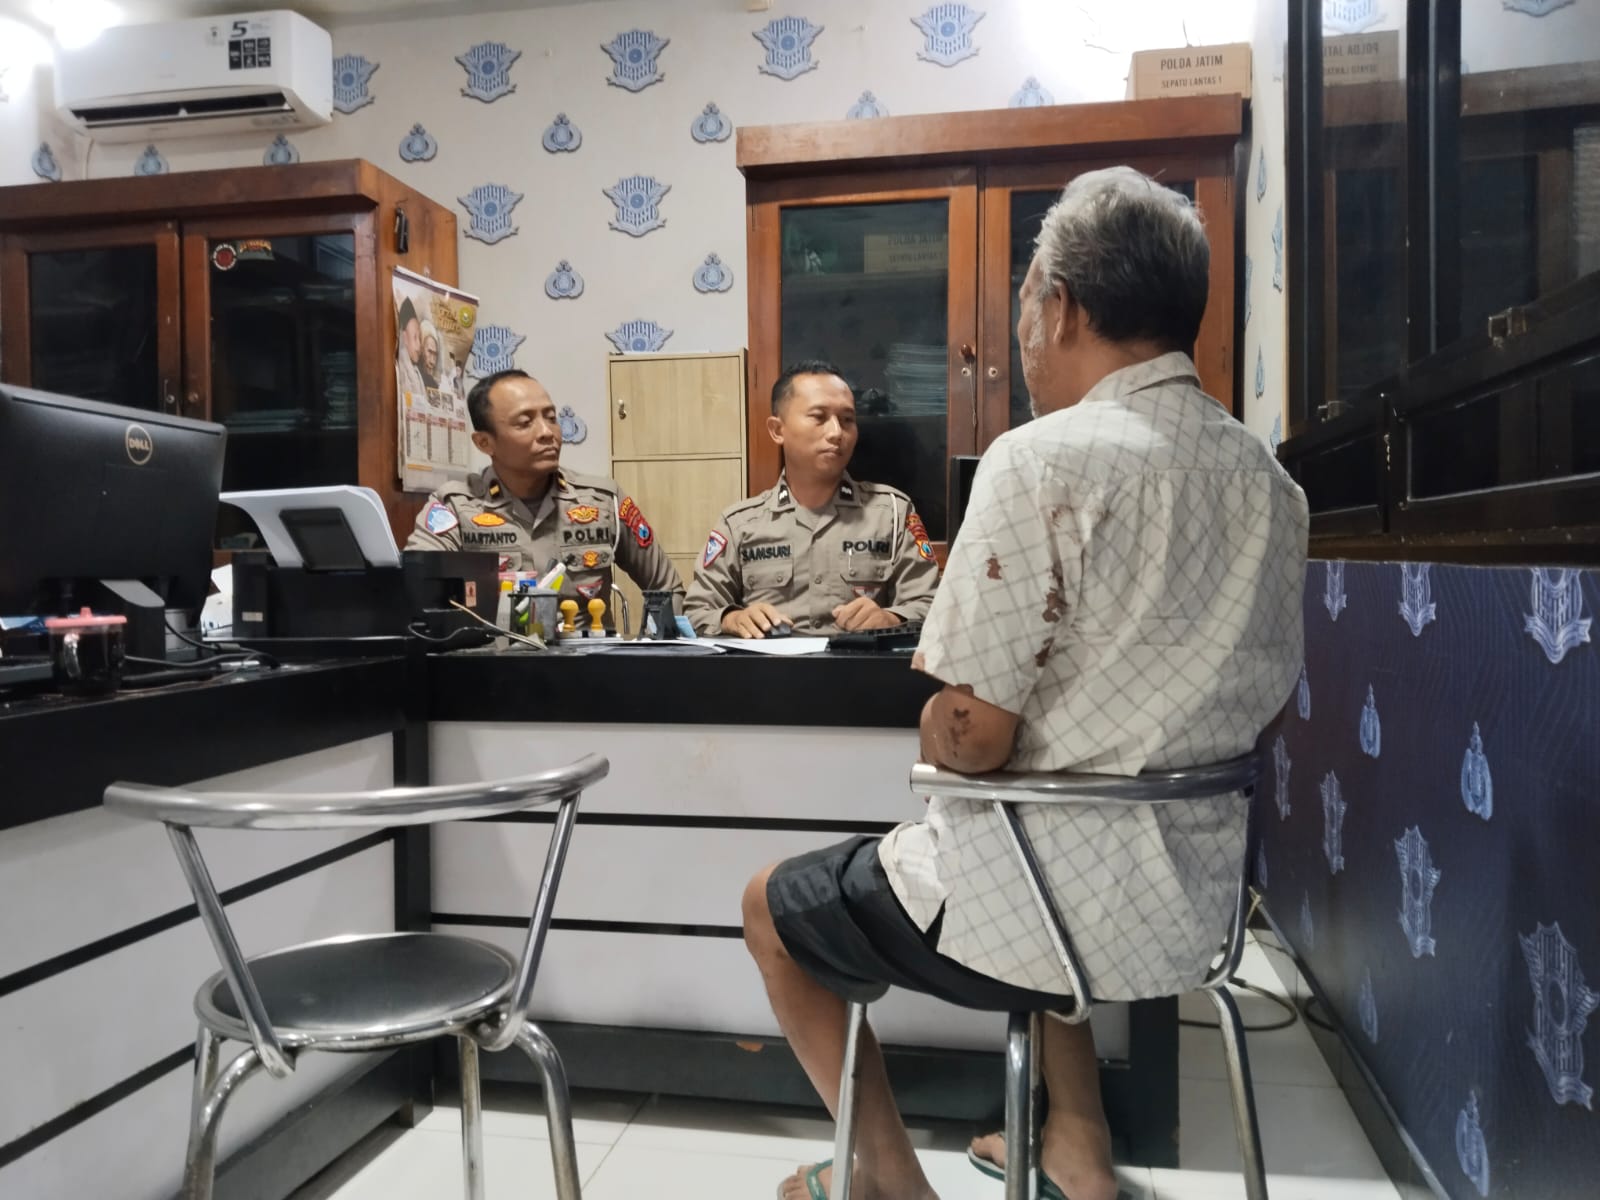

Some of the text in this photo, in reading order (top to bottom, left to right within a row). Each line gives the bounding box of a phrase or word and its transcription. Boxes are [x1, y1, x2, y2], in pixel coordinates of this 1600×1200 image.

[230, 20, 249, 38] 5
[1160, 54, 1223, 71] POLDA JATIM
[1161, 77, 1188, 89] SEPATU
[1190, 76, 1217, 87] LANTAS
[463, 531, 517, 545] HARTANTO
[563, 527, 609, 544] POLRI
[741, 544, 791, 561] SAMSURI
[842, 539, 890, 553] POLRI
